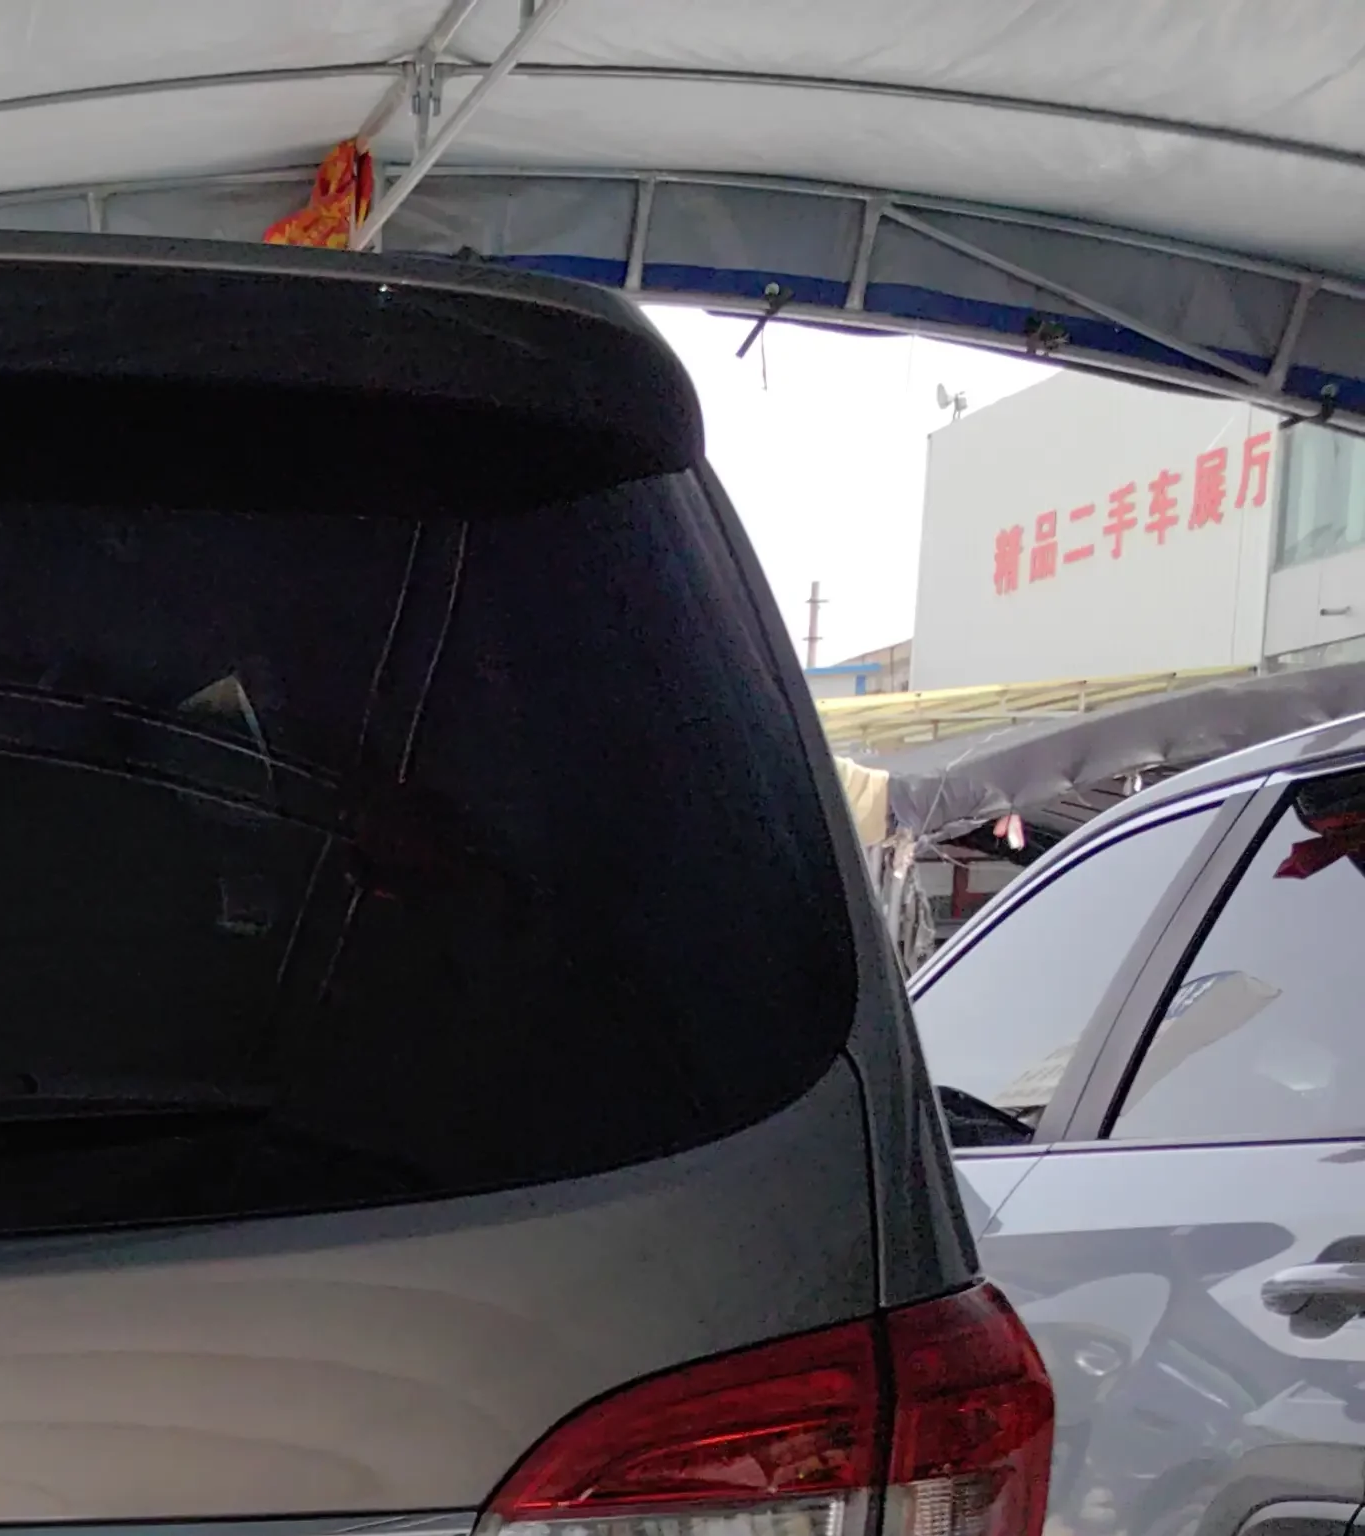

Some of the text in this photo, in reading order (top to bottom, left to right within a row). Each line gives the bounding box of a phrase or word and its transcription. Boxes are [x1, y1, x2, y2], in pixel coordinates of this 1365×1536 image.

[994, 431, 1271, 595] 精品二手车展厅
